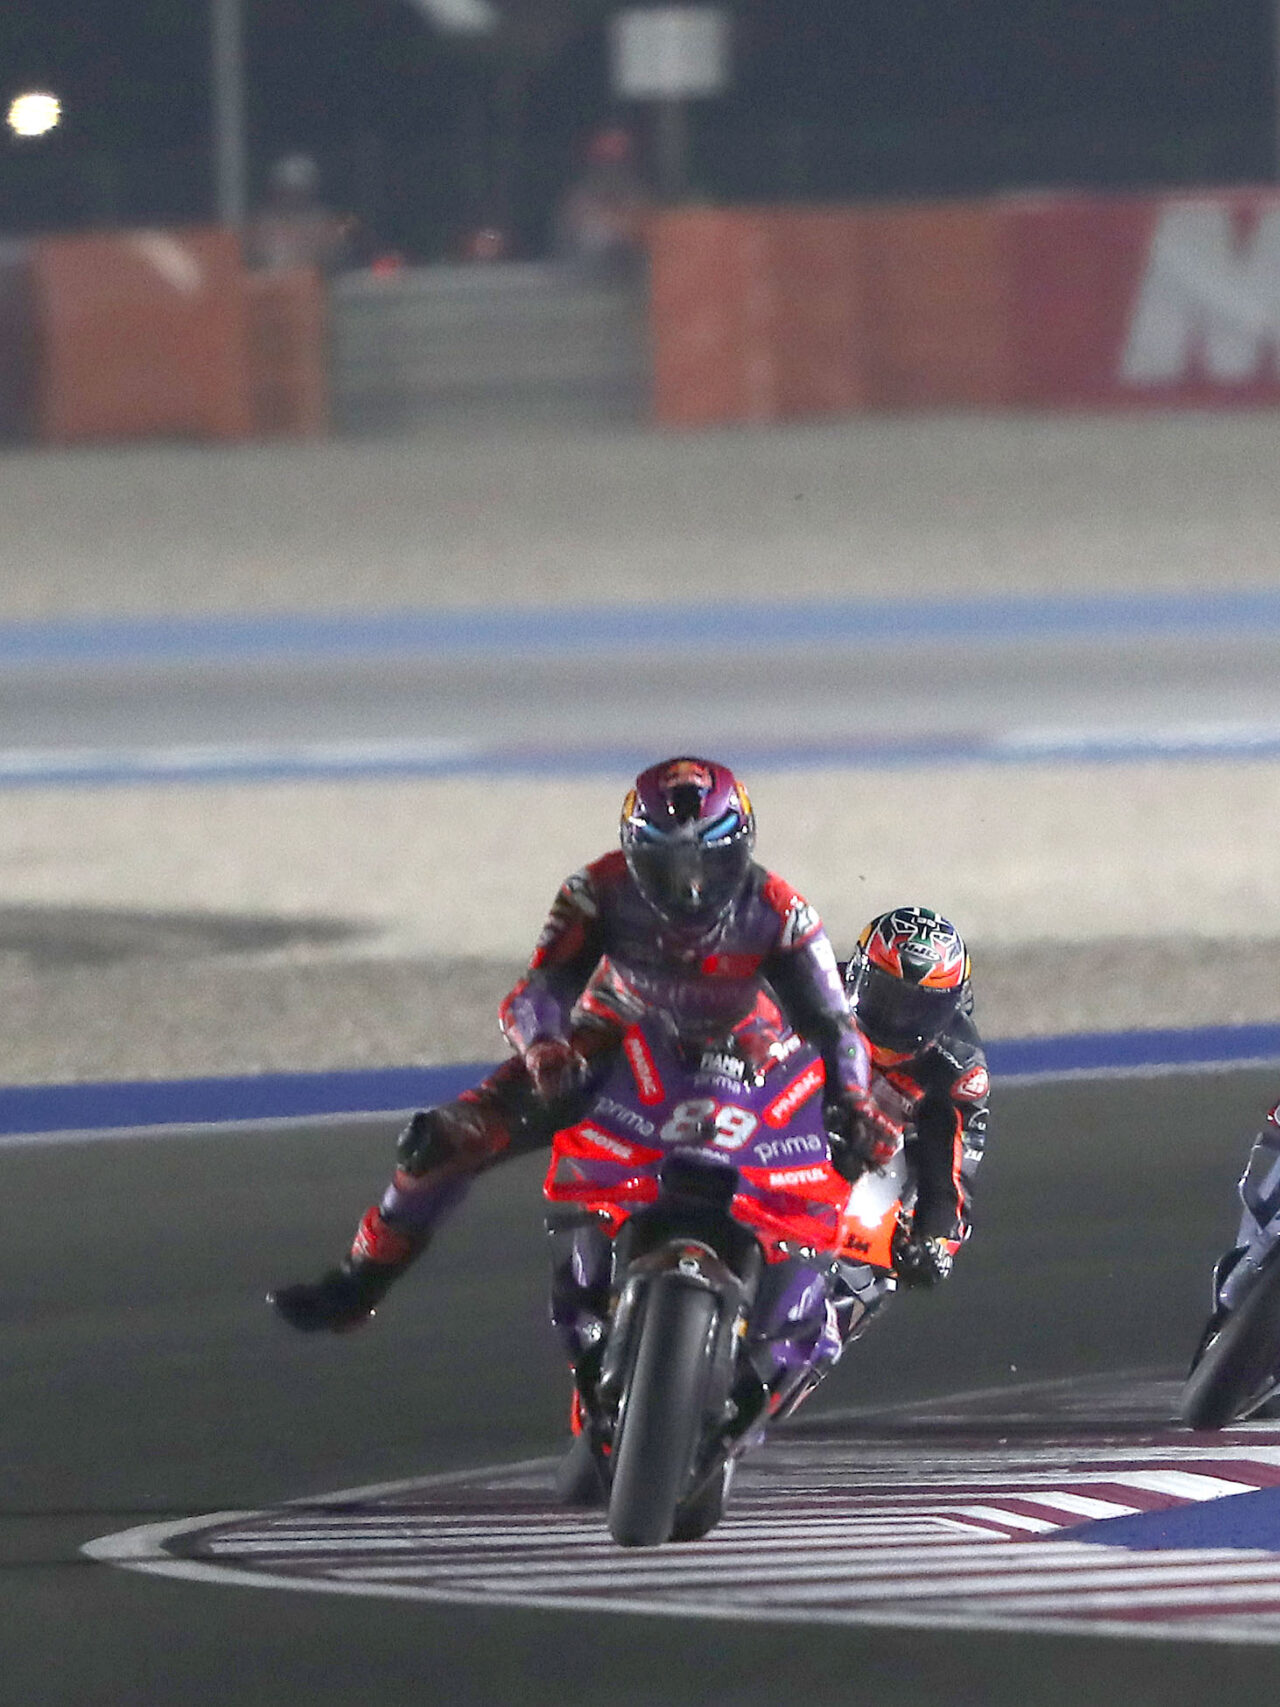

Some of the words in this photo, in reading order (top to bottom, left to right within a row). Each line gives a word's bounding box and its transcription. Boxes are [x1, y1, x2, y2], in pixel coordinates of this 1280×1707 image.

[594, 1096, 655, 1137] prima
[659, 1098, 758, 1149] 89
[580, 1128, 634, 1160] MOTUL
[753, 1134, 822, 1165] prima
[769, 1168, 828, 1187] MOTUL
